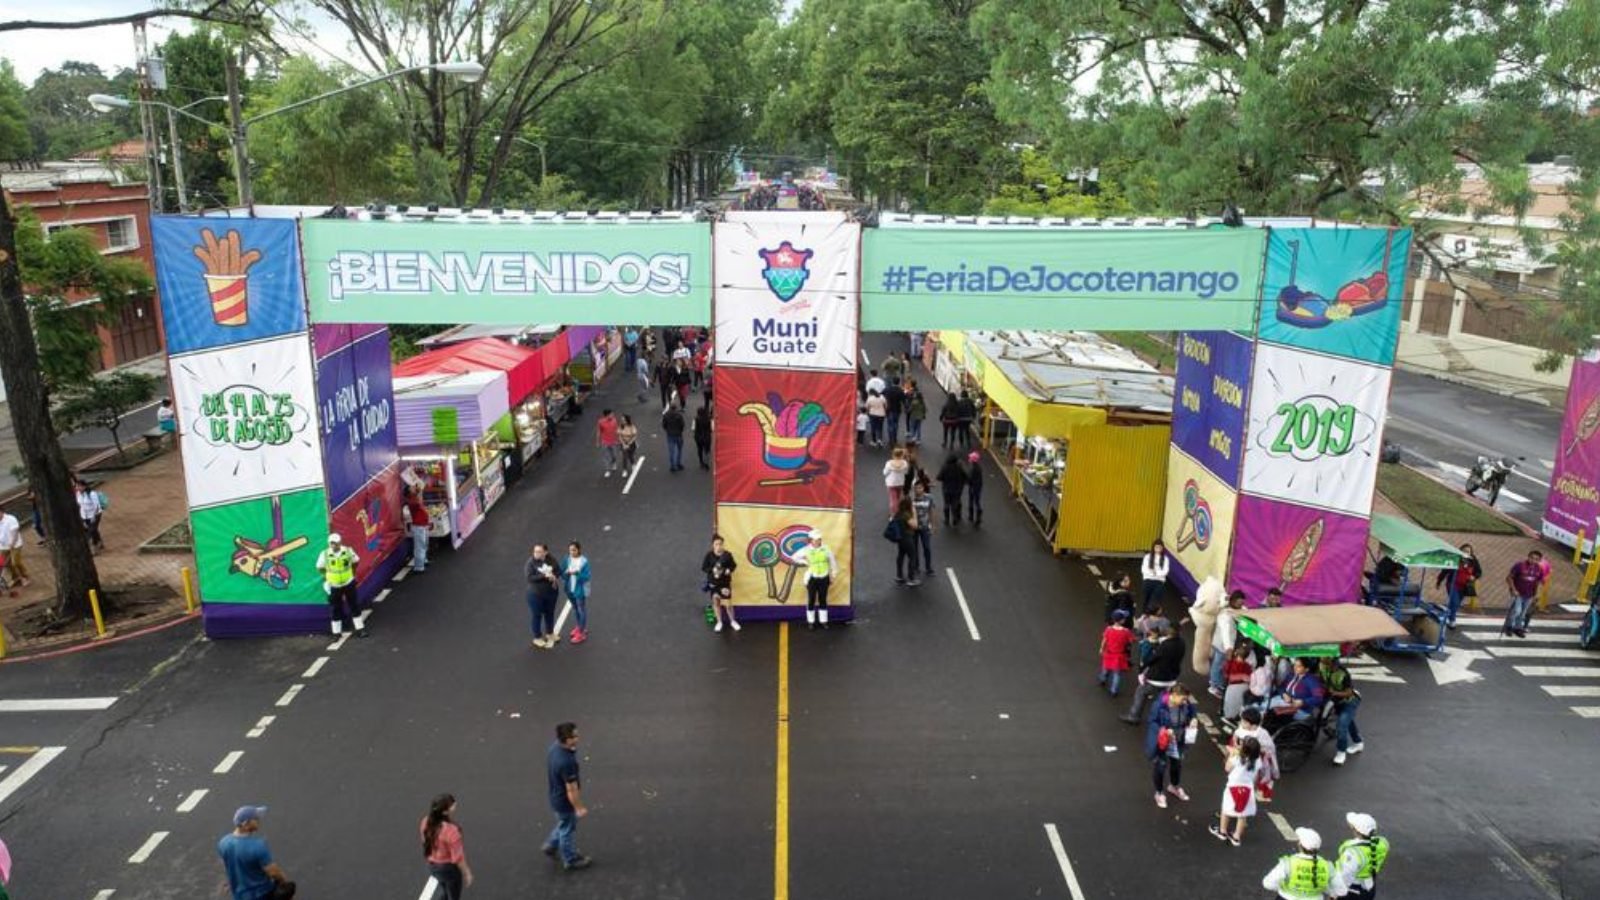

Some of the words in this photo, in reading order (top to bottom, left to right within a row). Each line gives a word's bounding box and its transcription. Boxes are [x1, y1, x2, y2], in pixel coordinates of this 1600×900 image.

[328, 250, 692, 301] ¡BIENVENIDOS!
[881, 263, 1239, 298] #FeriaDeJocotenango
[752, 316, 818, 337] Muni
[753, 337, 817, 353] Guate
[202, 393, 228, 417] DEL
[252, 393, 270, 417] AL
[271, 393, 295, 417] 25
[324, 399, 335, 434] LA
[210, 418, 231, 442] DE
[235, 416, 293, 445] AGOSTO
[348, 418, 361, 451] LA
[1271, 403, 1356, 454] 2019
